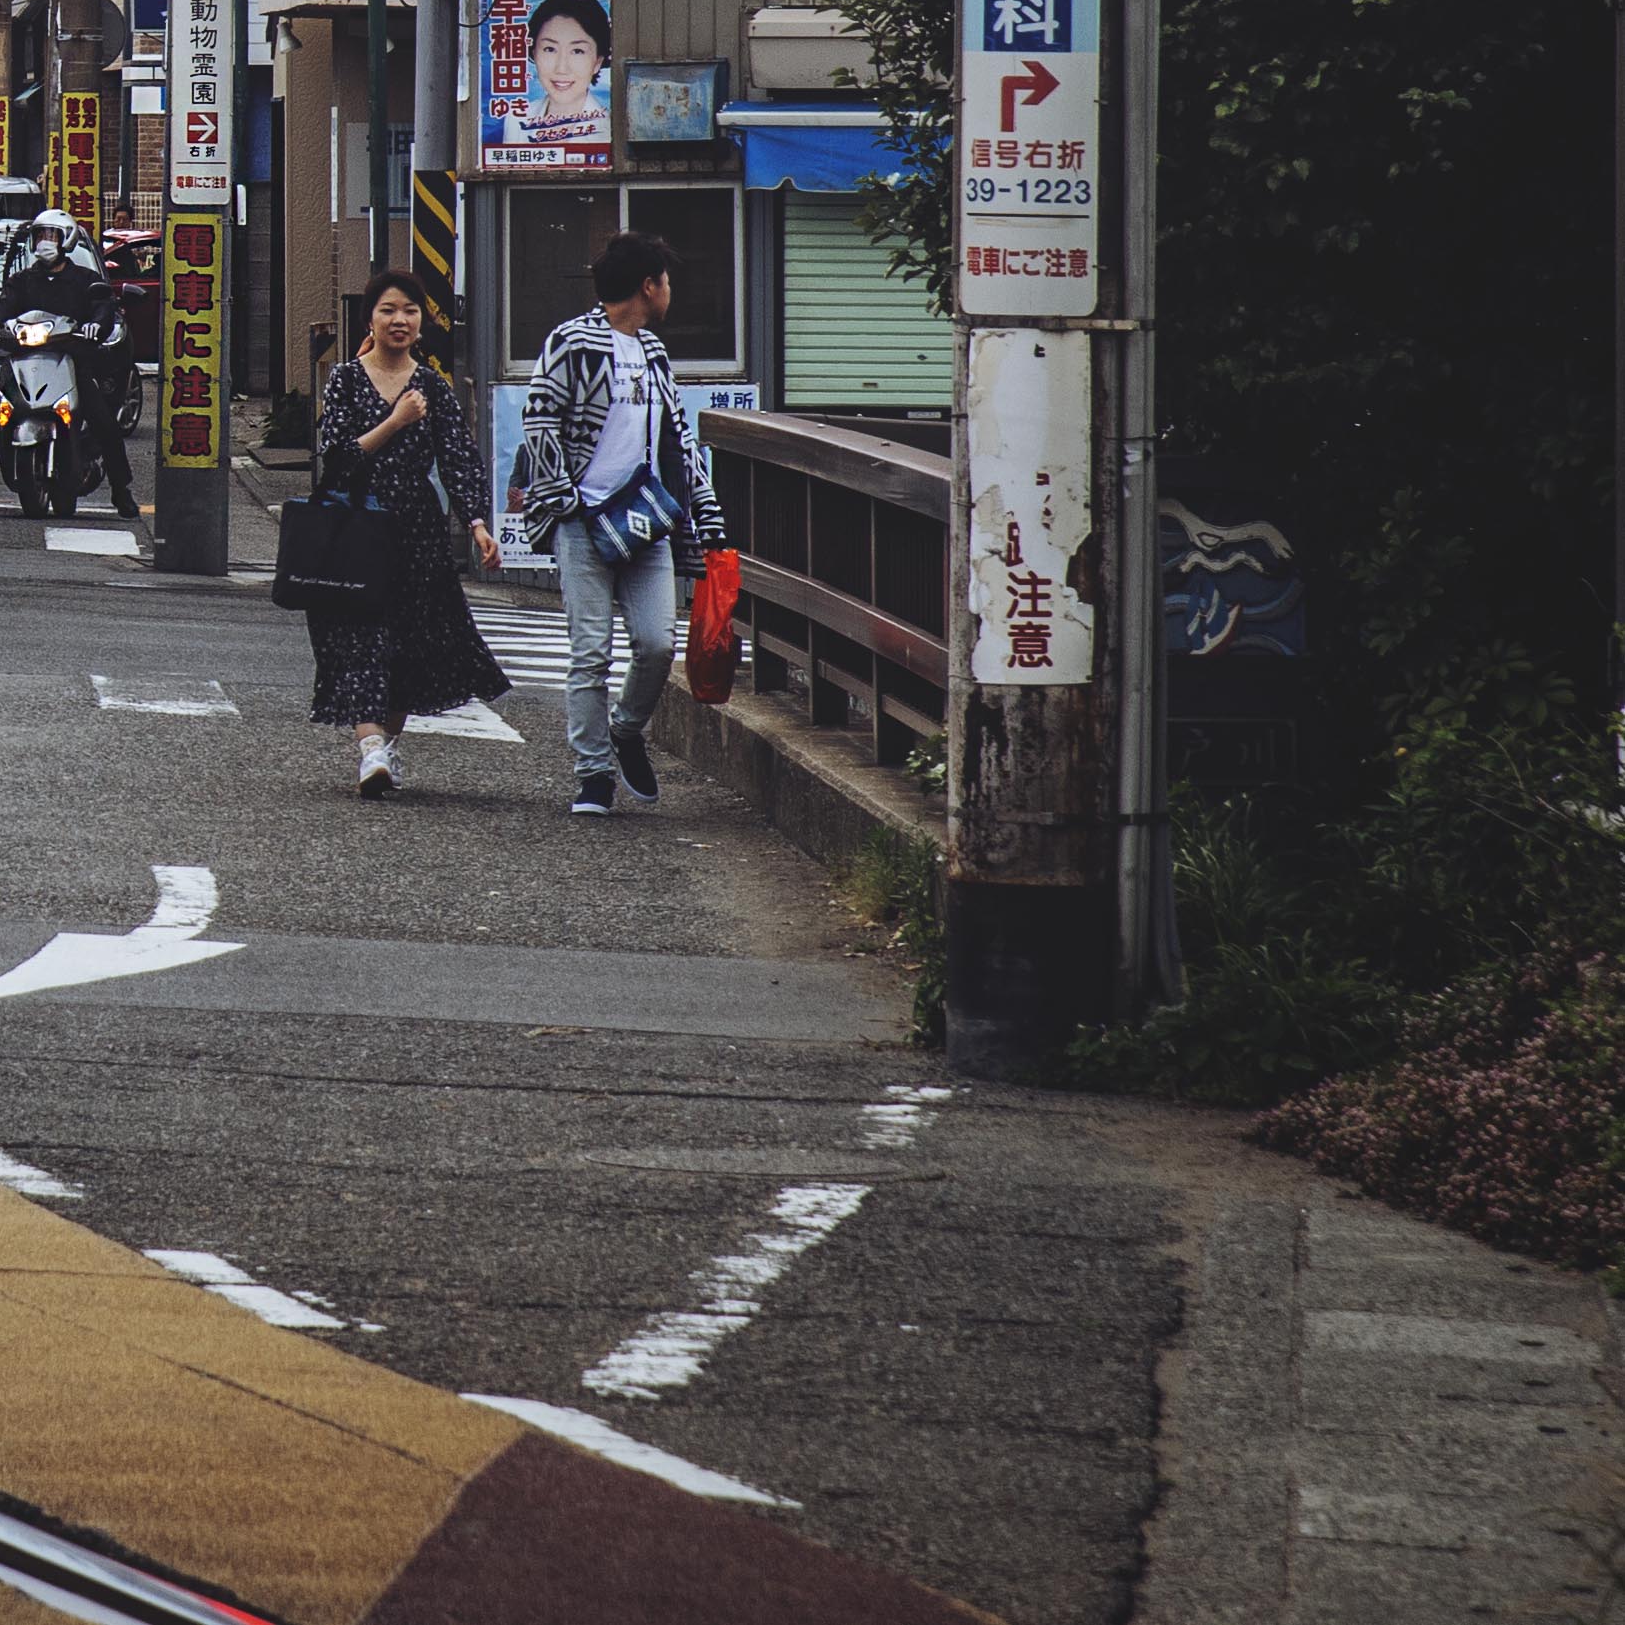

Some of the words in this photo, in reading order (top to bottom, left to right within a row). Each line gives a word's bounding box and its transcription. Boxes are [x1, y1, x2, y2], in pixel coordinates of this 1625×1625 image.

[490, 98, 530, 118] ゆき
[189, 146, 217, 158] 右折
[491, 150, 558, 163] 早稲田ゆき
[970, 138, 1086, 170] 信号右折
[965, 177, 1092, 205] 39-1223
[966, 246, 1089, 278] 電車にご注意
[169, 223, 216, 457] 電車に注意
[1005, 570, 1054, 669] 注意
